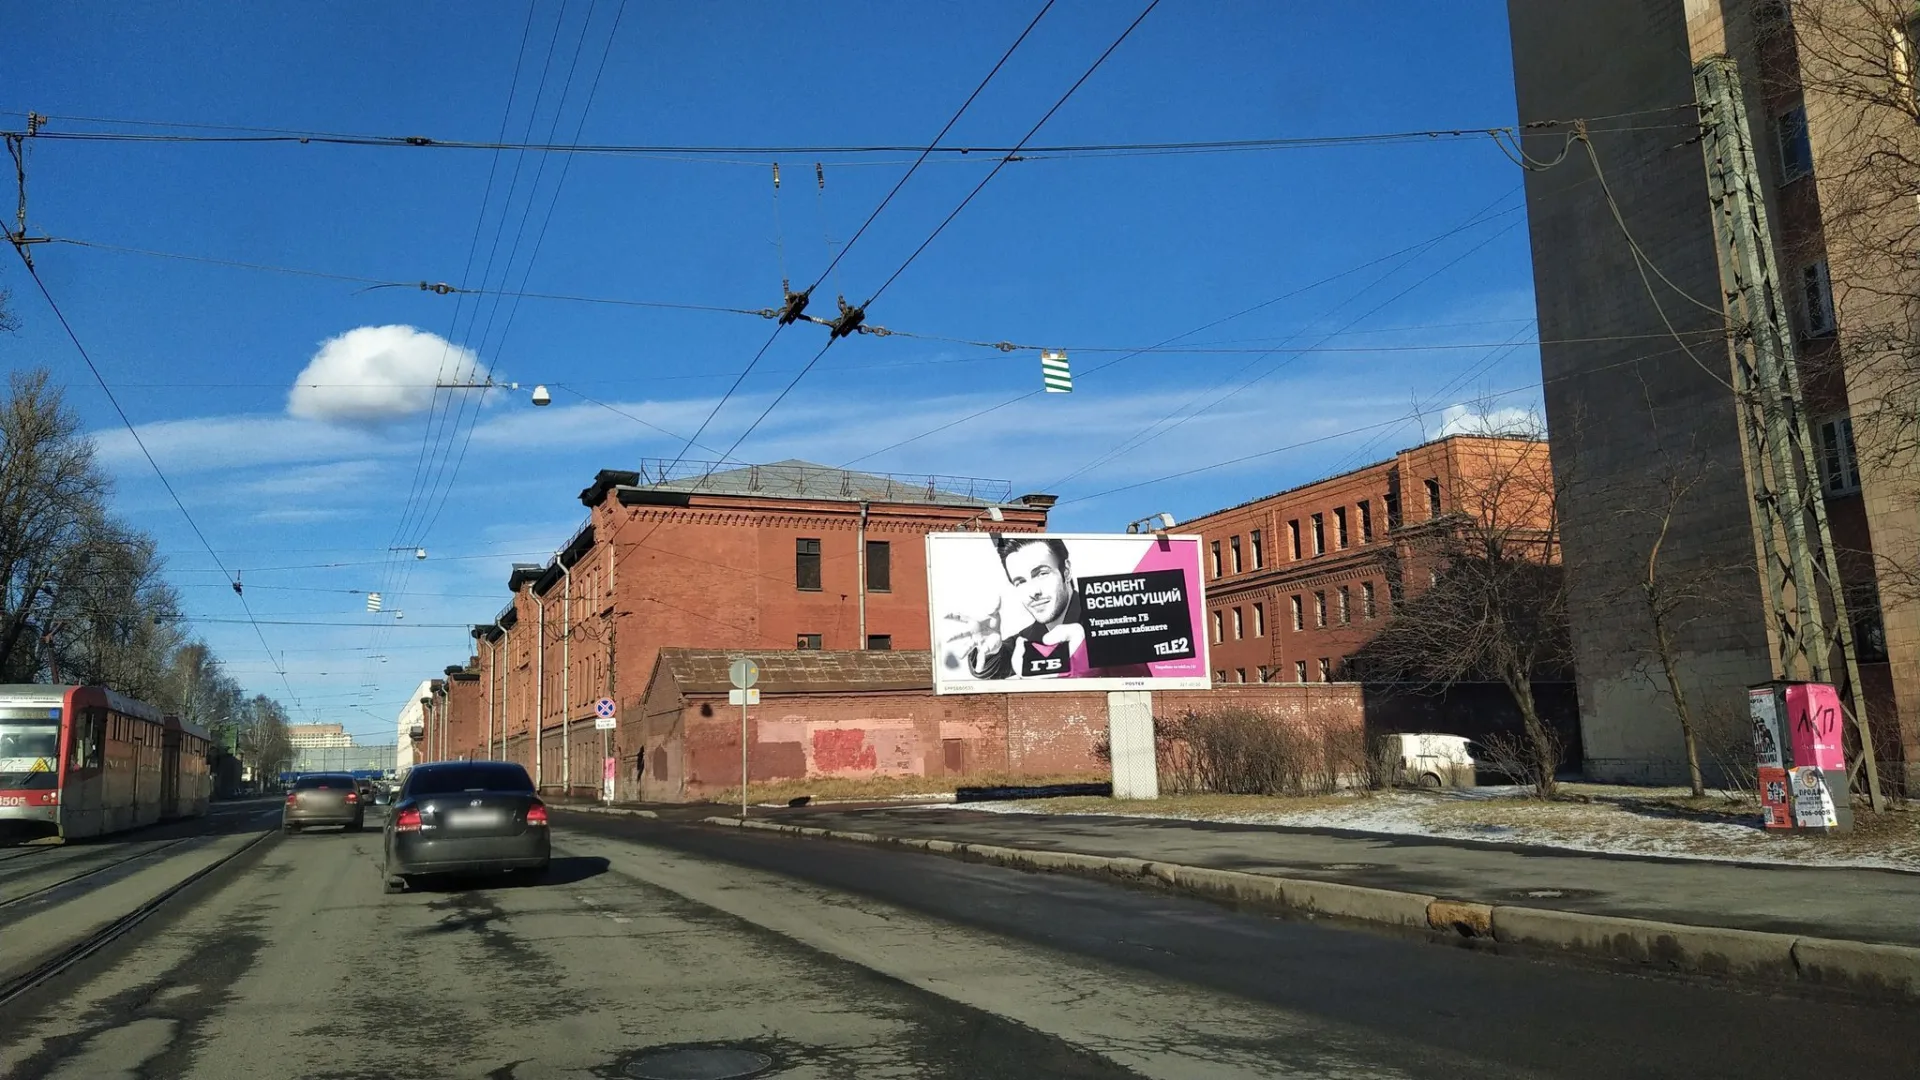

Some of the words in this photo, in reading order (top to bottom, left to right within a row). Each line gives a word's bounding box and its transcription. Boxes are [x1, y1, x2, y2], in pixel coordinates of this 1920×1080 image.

[1085, 579, 1146, 595] АБОНЕНТ
[1086, 588, 1182, 610] ВСЕМОГУЩИЙ
[1089, 615, 1137, 628] Управляйте
[1138, 613, 1149, 622] ГБ
[1098, 626, 1130, 637] личном
[1131, 624, 1168, 634] кабинете
[1154, 637, 1189, 655] TELE2
[1030, 658, 1062, 672] ГБ
